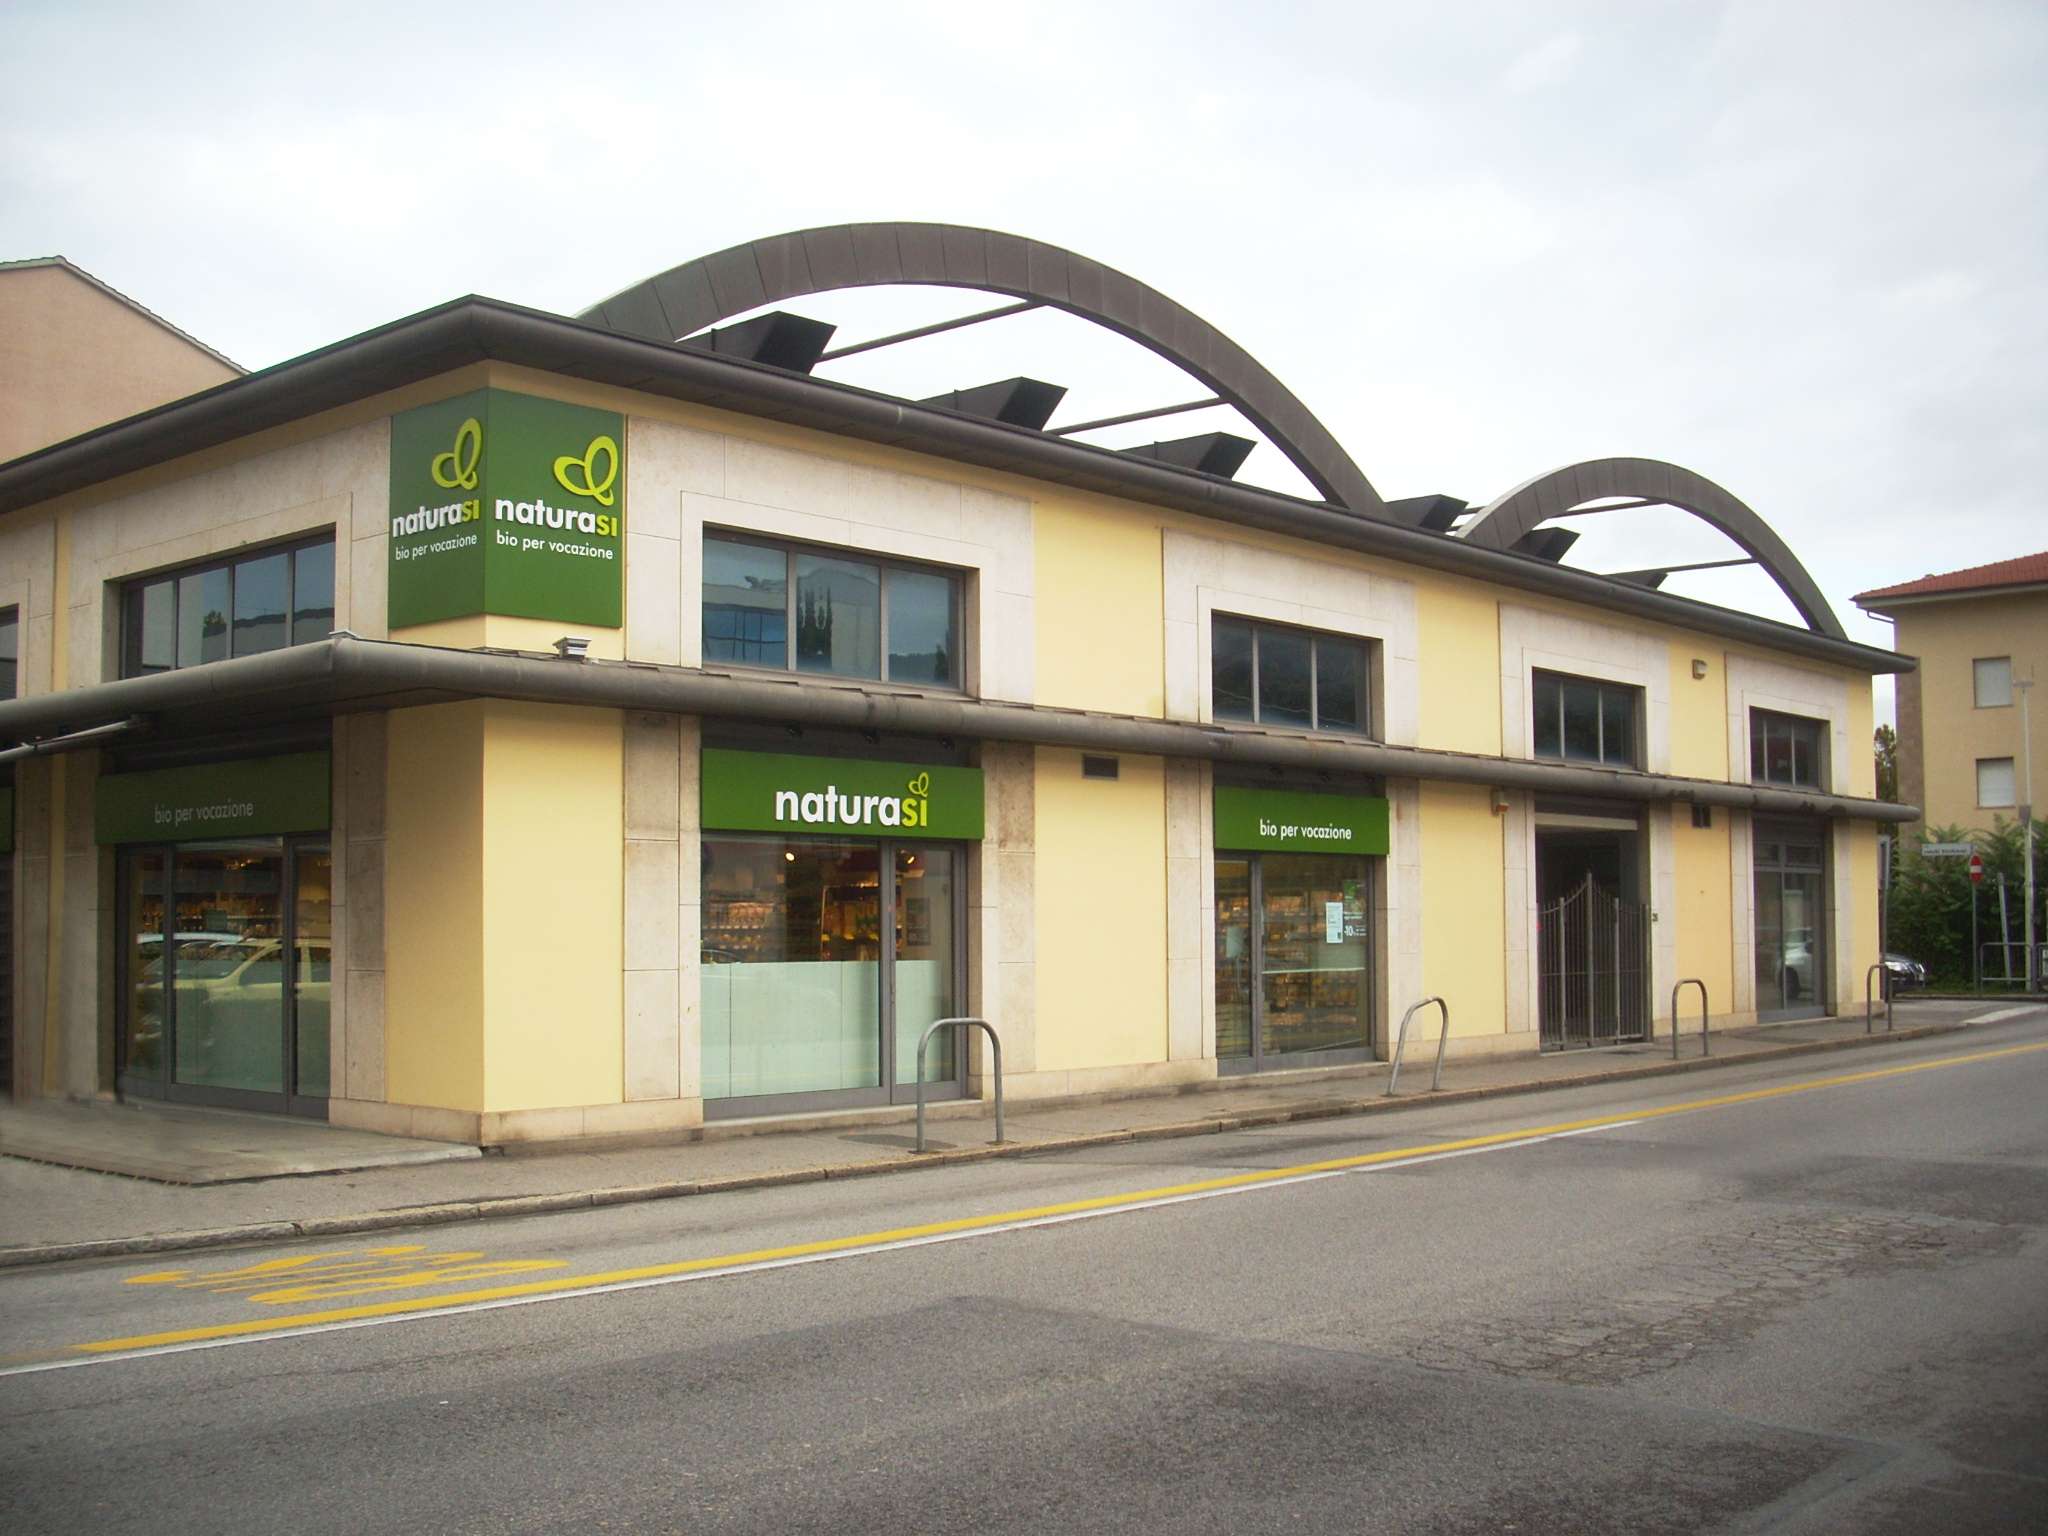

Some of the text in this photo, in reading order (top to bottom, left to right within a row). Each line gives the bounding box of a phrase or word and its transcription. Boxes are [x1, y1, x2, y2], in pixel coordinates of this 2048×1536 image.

[395, 534, 477, 561] bio per vocazione
[496, 529, 613, 560] bio per vocazione
[154, 798, 254, 827] bio per vocazione
[1260, 818, 1352, 840] bio per vocazione
